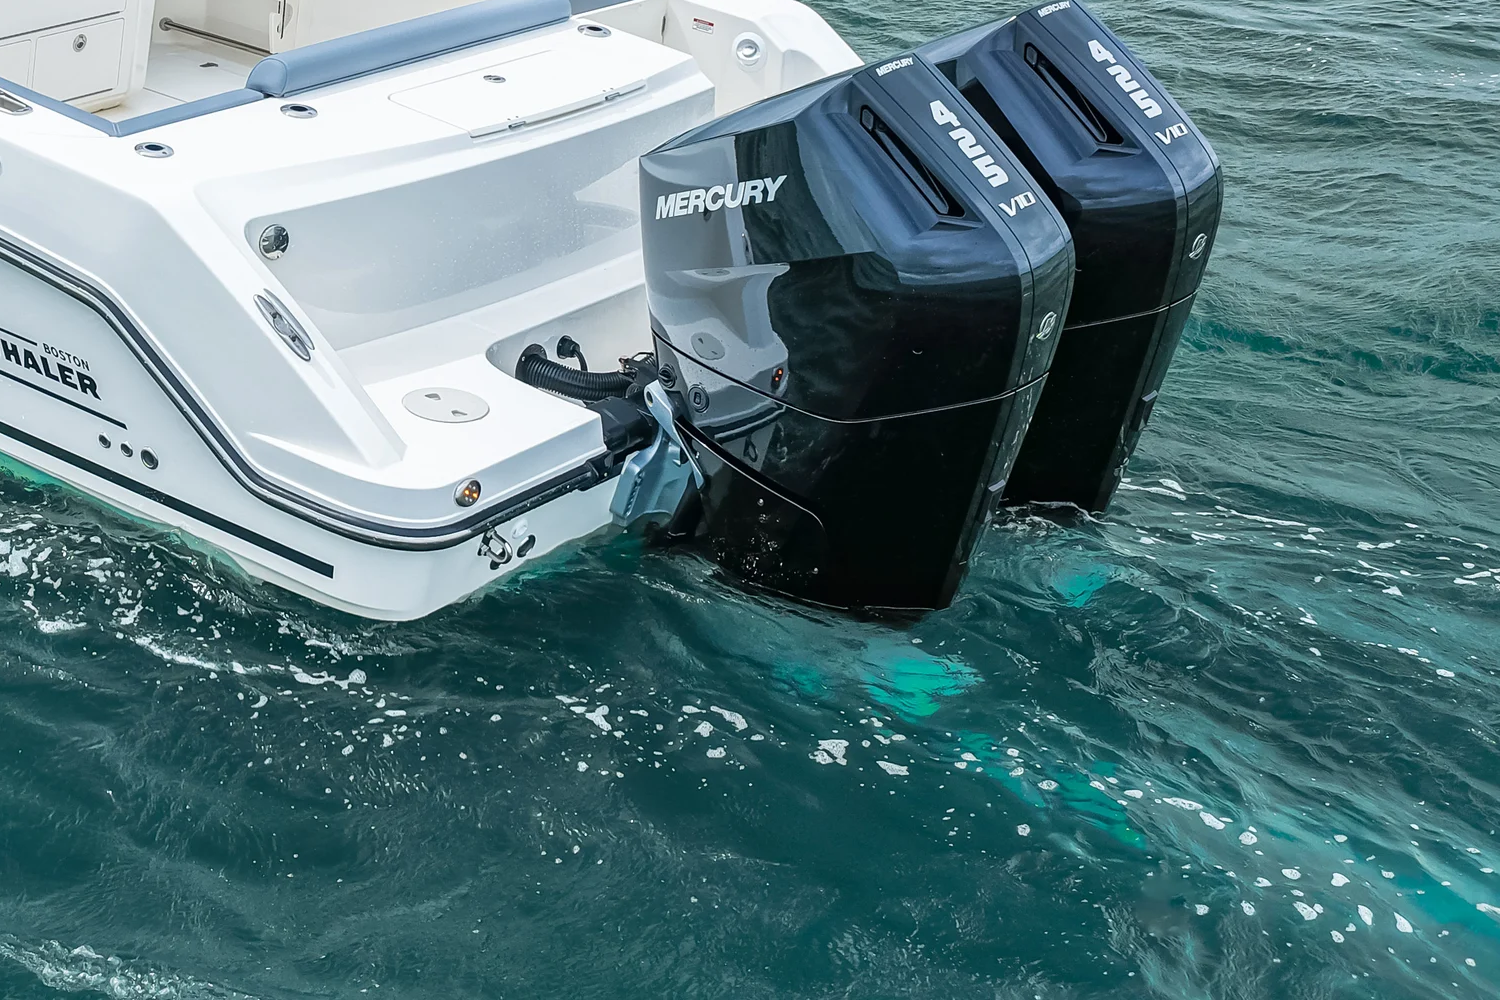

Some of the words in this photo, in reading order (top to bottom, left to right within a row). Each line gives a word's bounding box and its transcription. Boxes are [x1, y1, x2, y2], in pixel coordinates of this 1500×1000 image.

[1037, 0, 1071, 18] MERCURY
[875, 56, 914, 77] MERCURY
[1087, 39, 1163, 119] 425
[929, 99, 1009, 188] 425
[1154, 122, 1189, 145] V10
[655, 174, 788, 220] MERCURY
[997, 191, 1037, 218] V10
[42, 342, 90, 372] BOSTON
